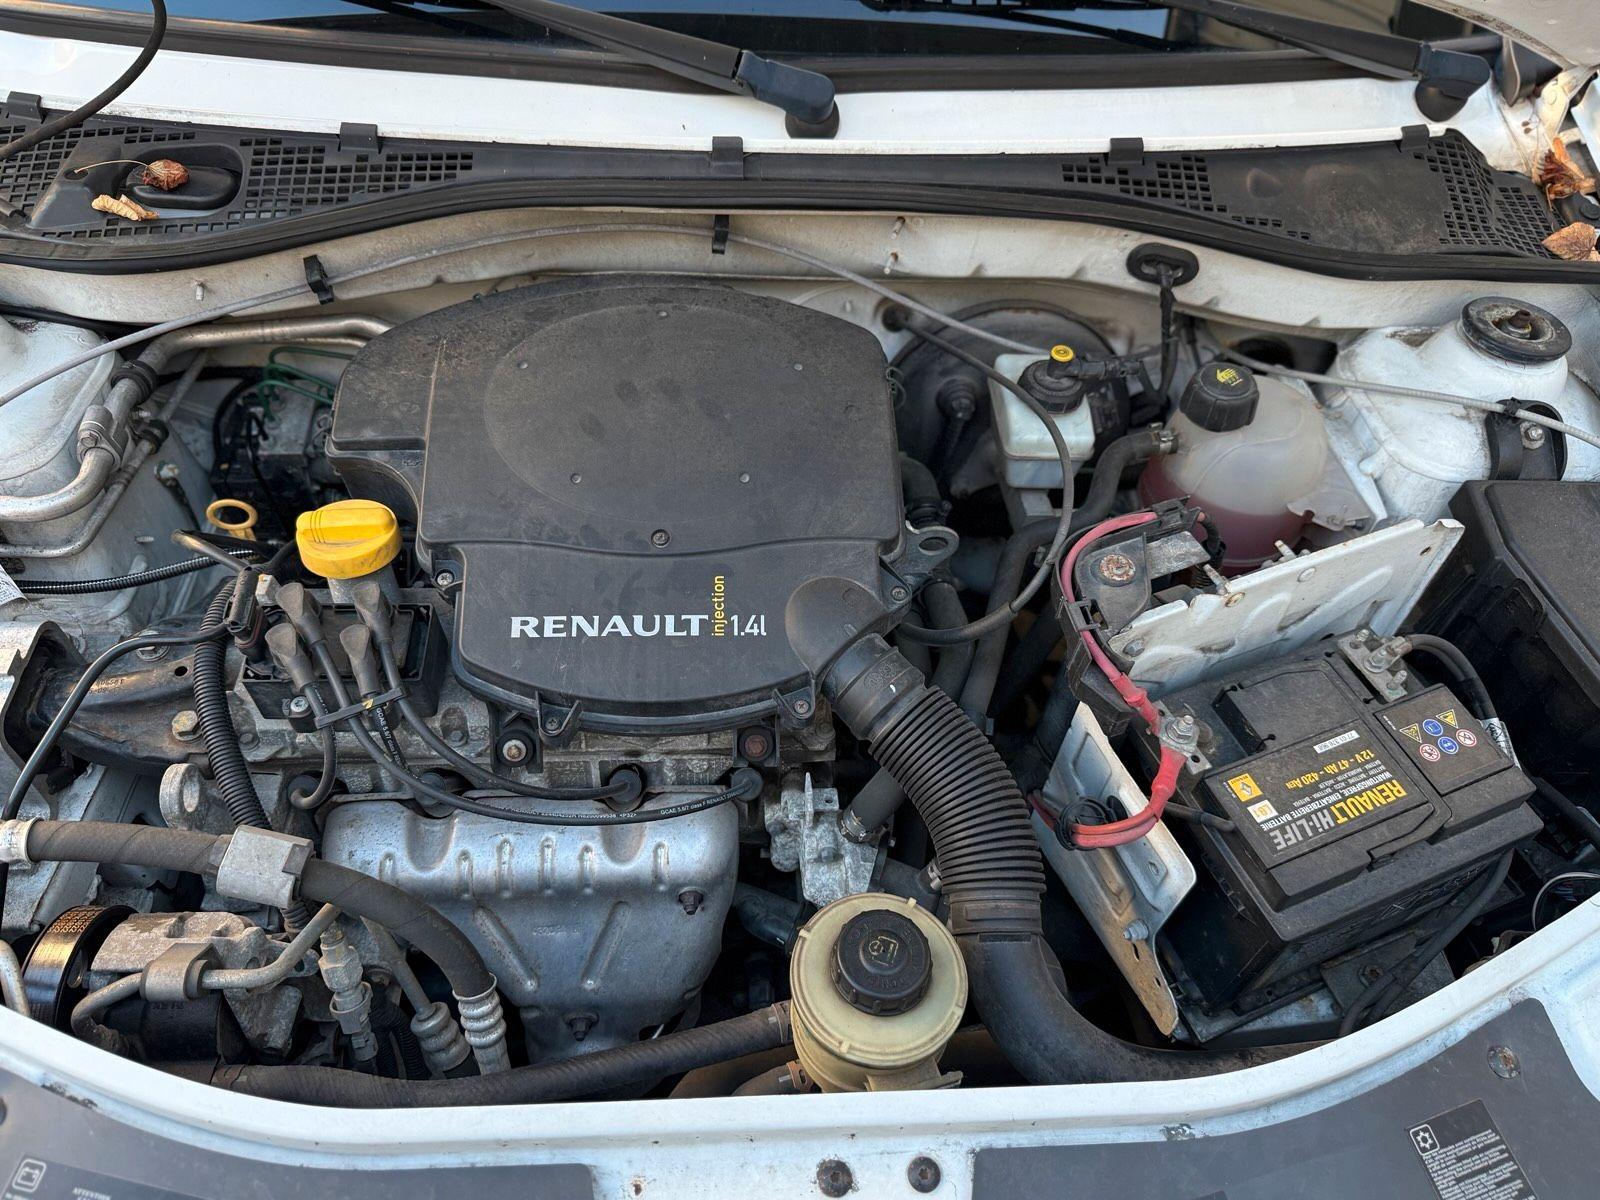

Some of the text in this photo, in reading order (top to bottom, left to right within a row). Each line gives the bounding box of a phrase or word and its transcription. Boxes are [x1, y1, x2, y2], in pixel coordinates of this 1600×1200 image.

[510, 614, 709, 638] RENAULT
[711, 575, 728, 637] injection
[1323, 763, 1339, 774] Ah
[1338, 759, 1349, 771] 47
[1301, 772, 1319, 785] 420
[1290, 792, 1342, 818] EINSATZBEREITE
[1330, 779, 1408, 824] RENAULT
[1260, 813, 1293, 832] BATTERIE
